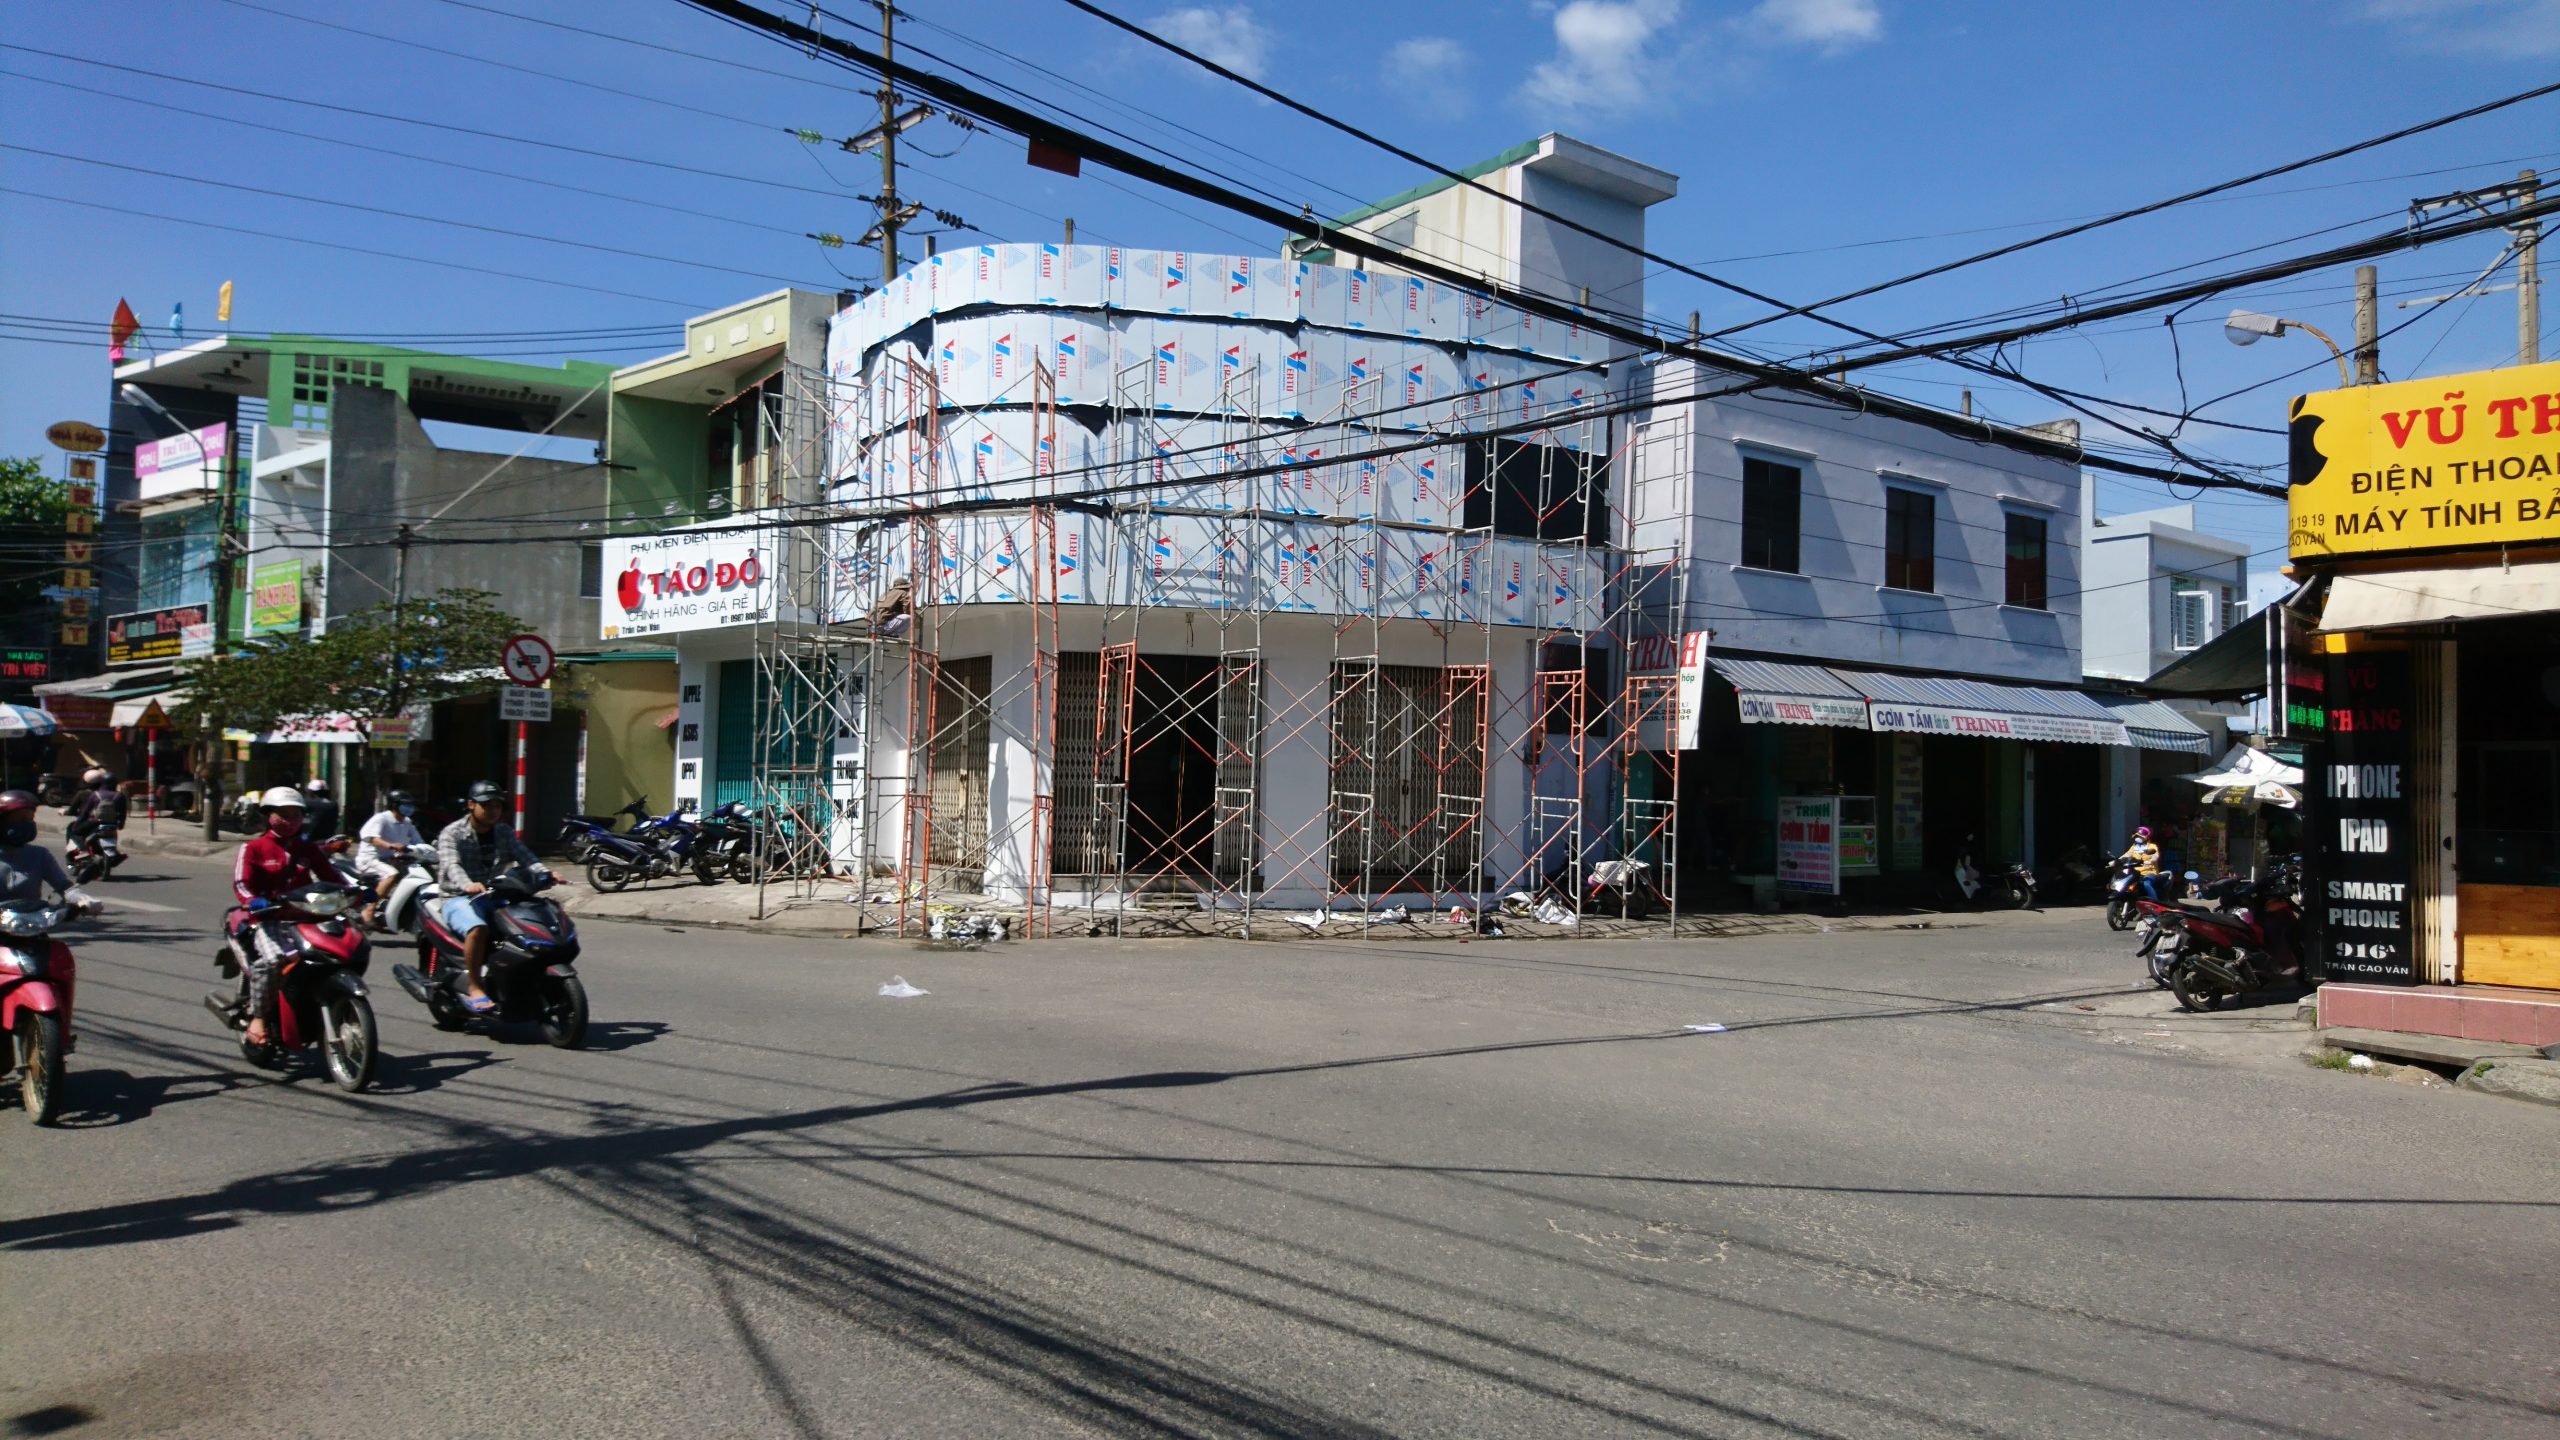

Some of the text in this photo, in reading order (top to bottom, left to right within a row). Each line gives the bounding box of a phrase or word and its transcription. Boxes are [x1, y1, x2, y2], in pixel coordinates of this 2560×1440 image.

[2381, 391, 2467, 449] VŨ
[2351, 464, 2432, 496] ĐIỆN
[2297, 515, 2308, 528] 19
[2312, 513, 2325, 526] 19
[2335, 506, 2408, 536] MÁY
[2421, 499, 2501, 529] TÍNH
[630, 541, 651, 554] PHỤ
[647, 548, 760, 595] TÁO ĐỎ
[708, 598, 727, 613] GIÁ
[1776, 702, 1813, 720] TRINH
[1876, 708, 1905, 727] CƠM
[1907, 708, 1933, 729] TẤM
[1951, 716, 2011, 733] TRINH
[681, 763, 697, 780] OPPO
[2327, 765, 2400, 798] IPHONE
[2340, 818, 2388, 853] IPAD
[2328, 881, 2405, 901] SMART
[2328, 908, 2400, 928] PHONE
[2358, 964, 2383, 973] CAO
